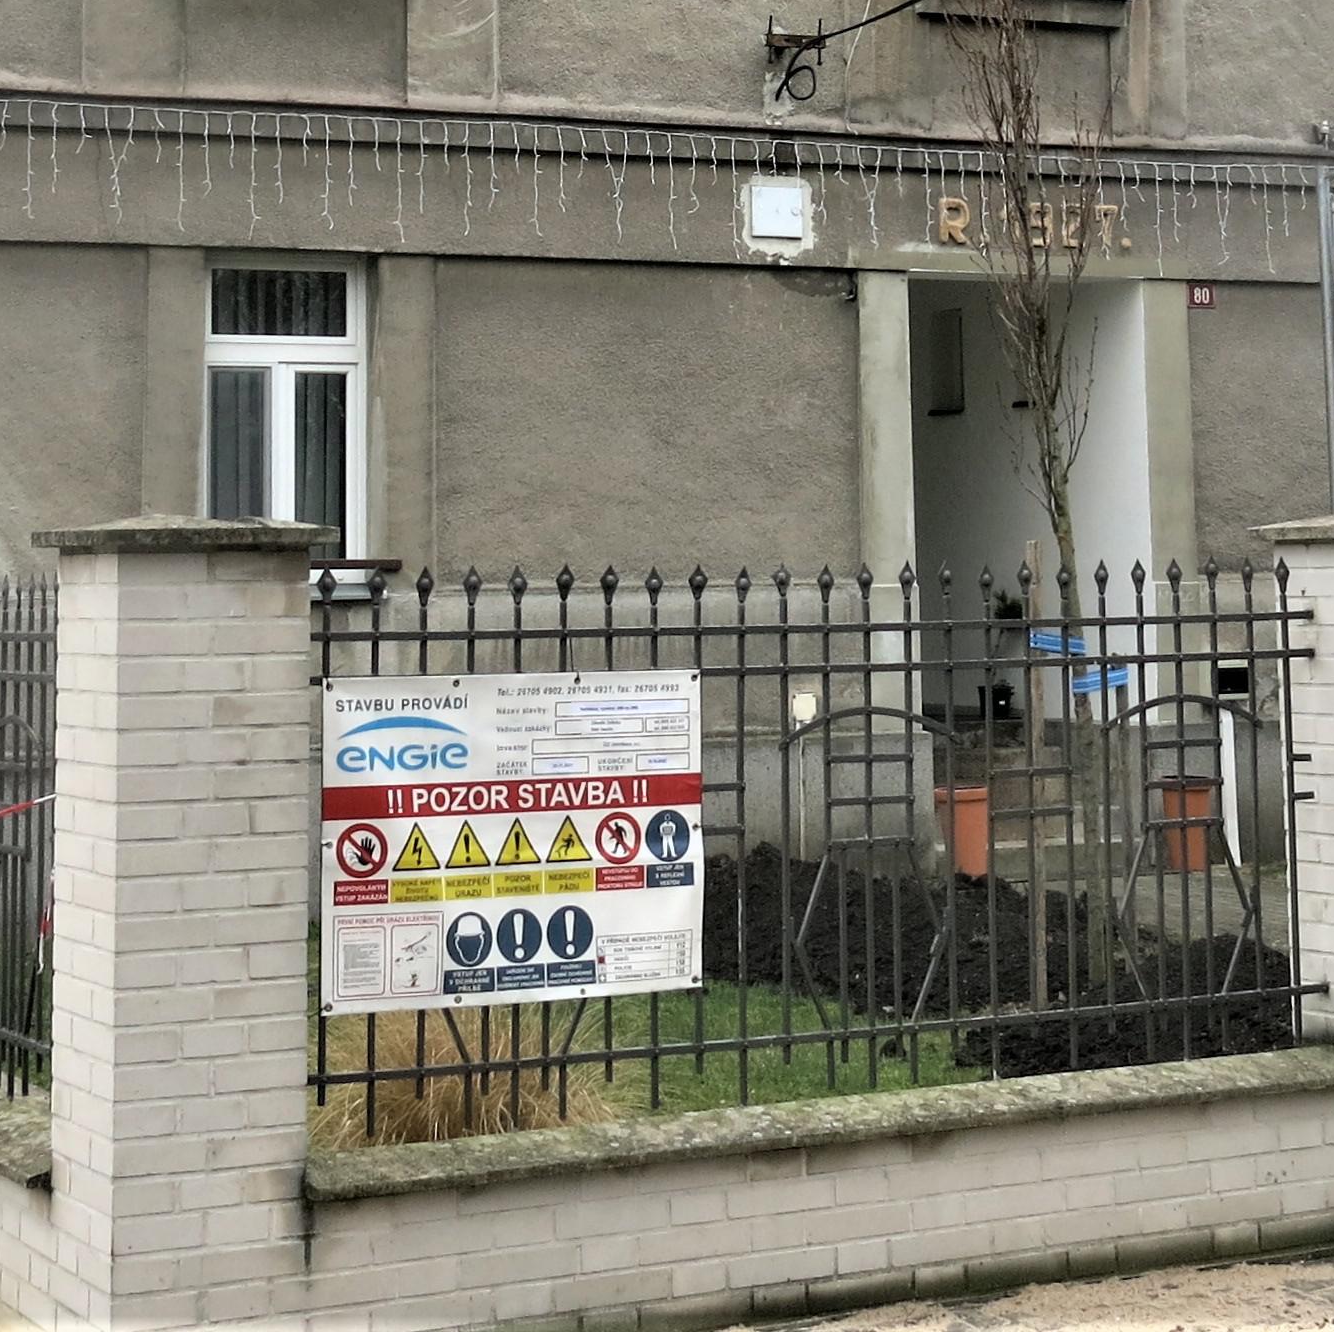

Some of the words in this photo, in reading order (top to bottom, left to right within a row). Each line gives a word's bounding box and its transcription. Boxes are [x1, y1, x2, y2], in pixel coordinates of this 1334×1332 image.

[1194, 287, 1210, 304] 80
[335, 699, 394, 712] STAVBU
[401, 693, 468, 710] PROVÁDÍ
[412, 785, 510, 812] POZOR
[517, 780, 624, 808] STAVBA
